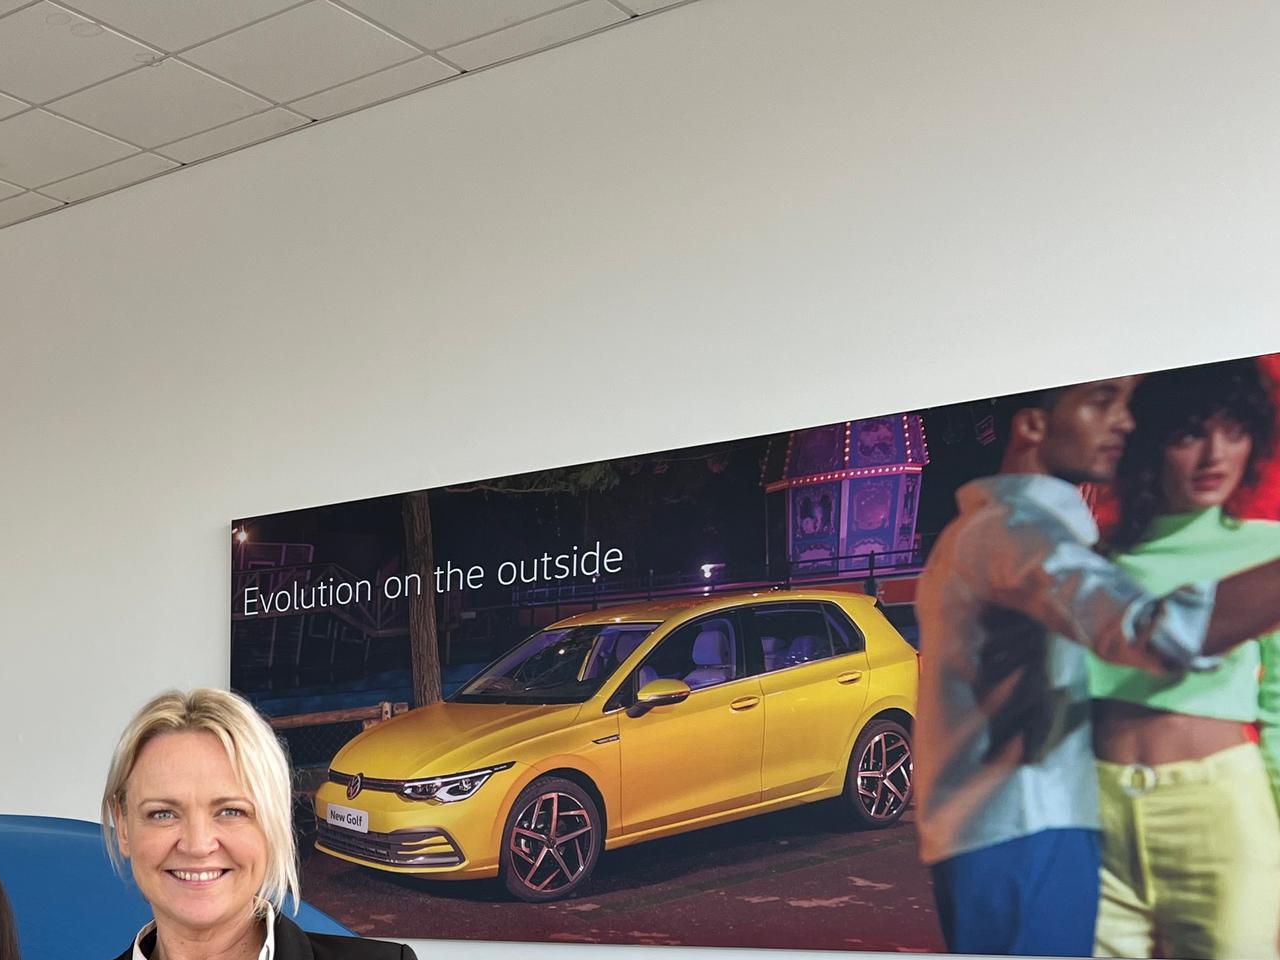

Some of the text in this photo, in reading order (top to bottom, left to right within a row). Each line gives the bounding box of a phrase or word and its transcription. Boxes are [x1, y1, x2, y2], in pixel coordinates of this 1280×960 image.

[244, 541, 624, 616] Evolution on the outside
[330, 809, 363, 826] New Golf
